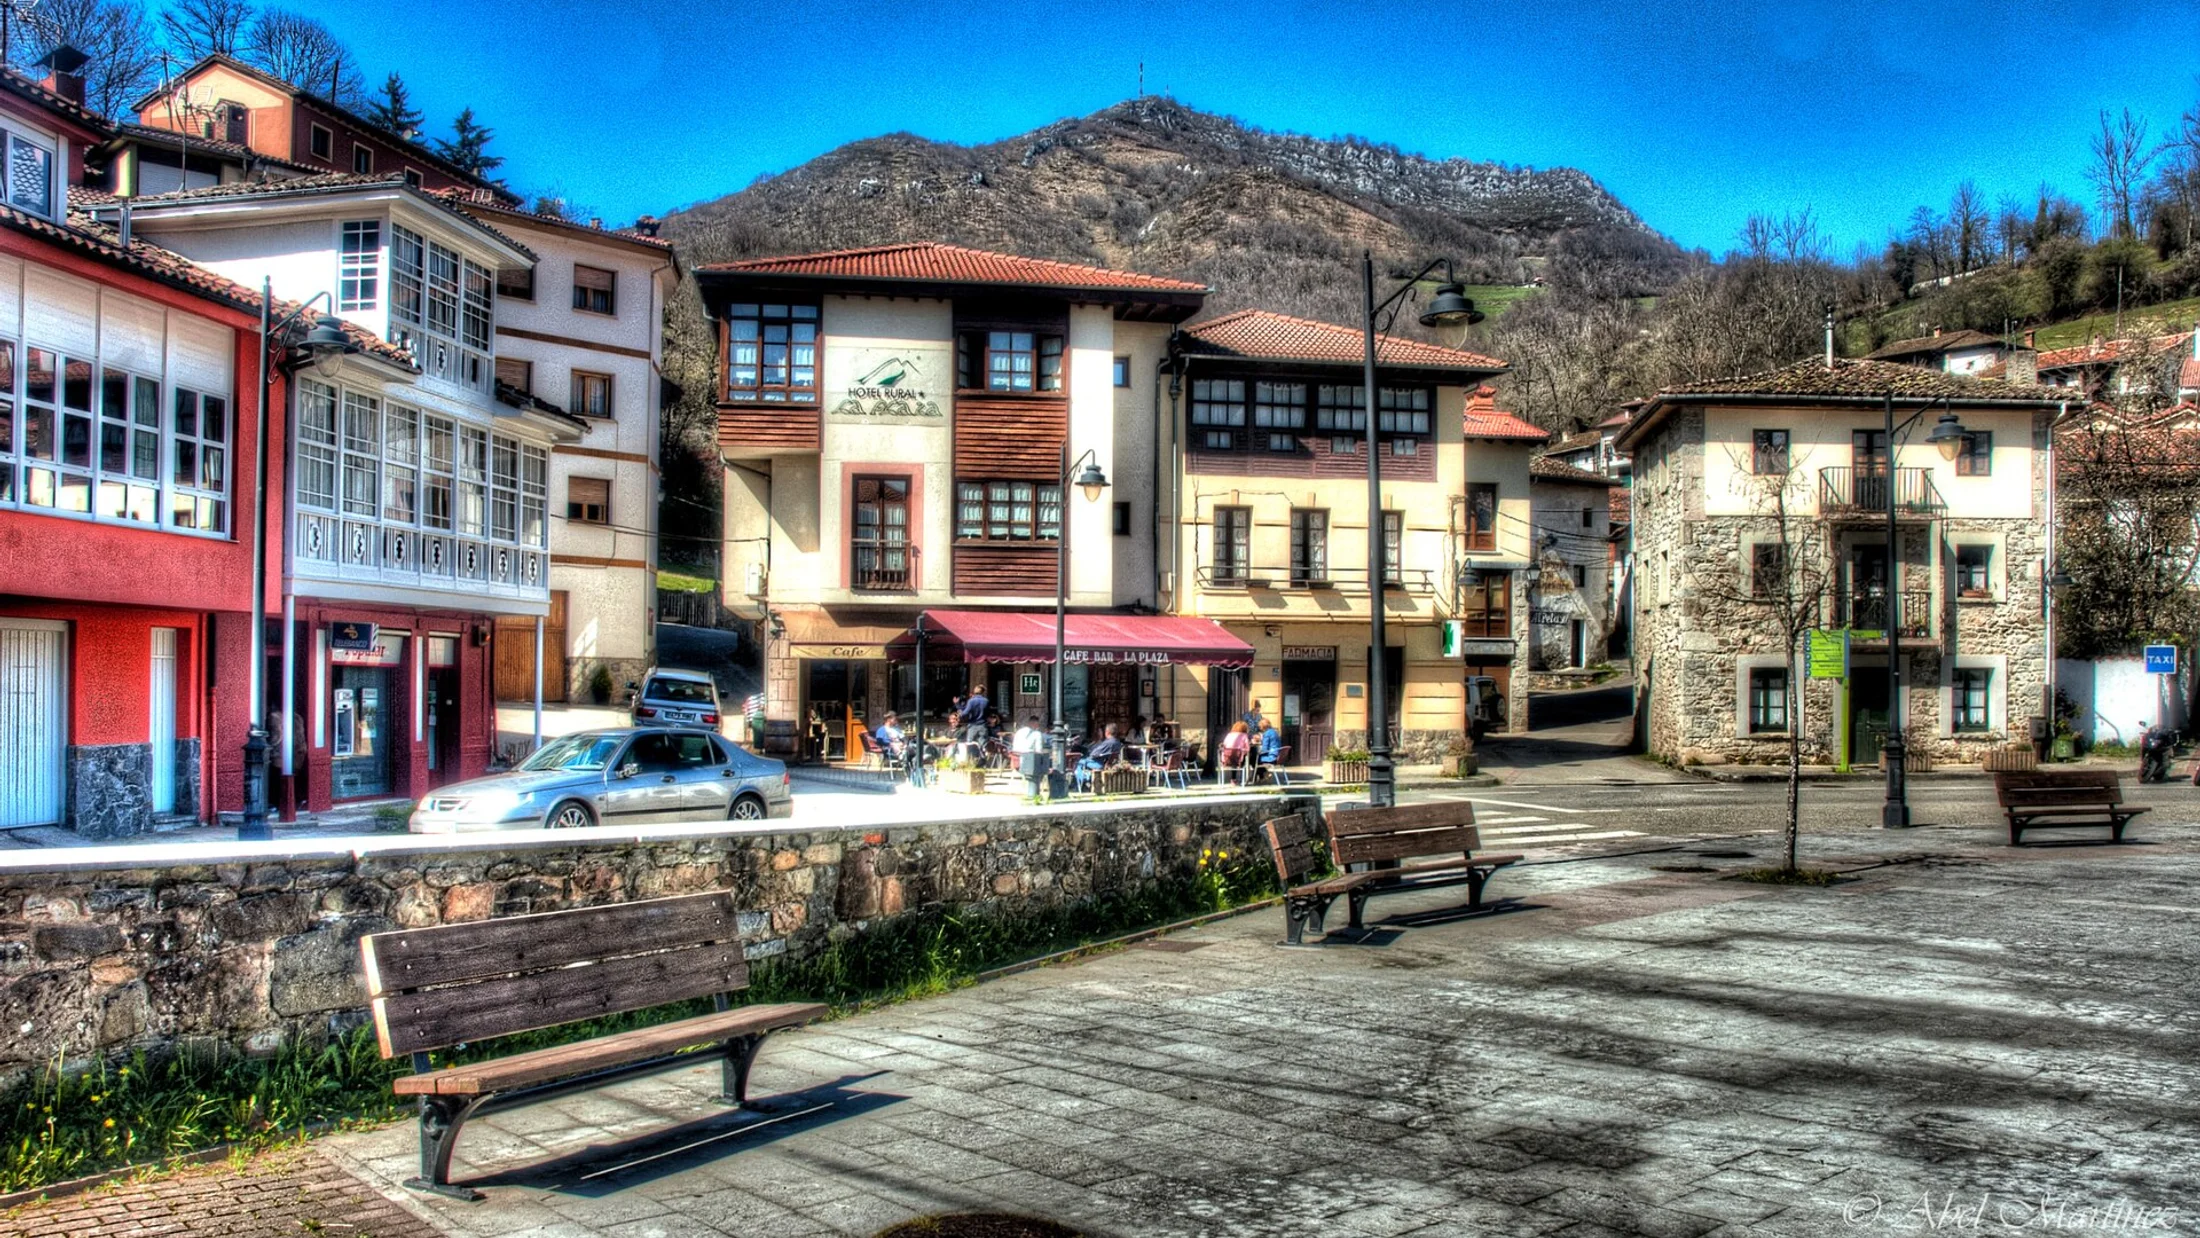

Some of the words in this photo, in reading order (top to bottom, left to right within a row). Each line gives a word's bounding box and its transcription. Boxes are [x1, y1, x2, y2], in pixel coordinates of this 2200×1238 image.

[848, 387, 881, 399] HOTEL
[884, 388, 917, 400] RURAL
[1063, 650, 1089, 661] CAFE
[1094, 651, 1114, 662] BAR
[1124, 652, 1137, 662] LA
[1139, 652, 1169, 663] PLAZA
[1282, 647, 1333, 658] FARMACIA
[2148, 655, 2174, 665] TAXI
